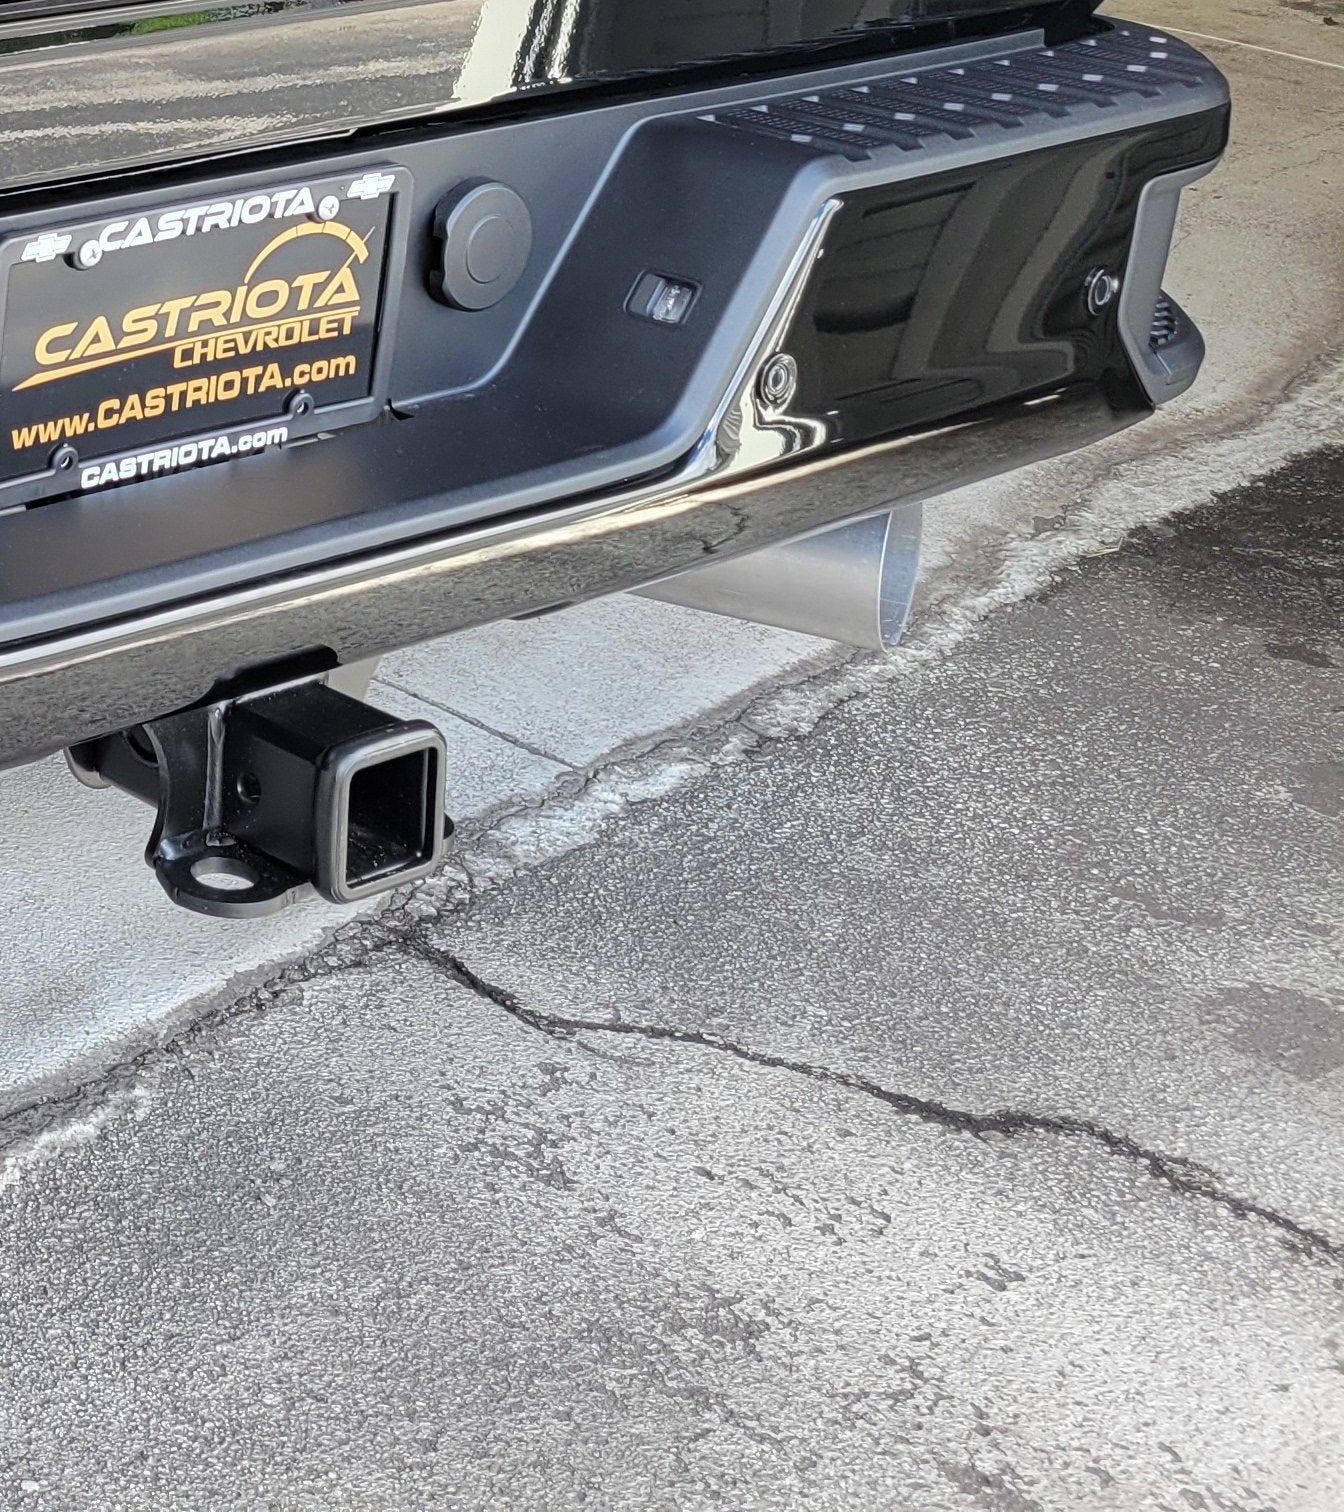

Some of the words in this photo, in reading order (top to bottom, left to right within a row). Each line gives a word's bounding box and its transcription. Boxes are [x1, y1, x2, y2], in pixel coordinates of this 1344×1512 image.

[98, 186, 316, 253] CASTRIOTA
[35, 266, 360, 365] CASTRIOTA
[173, 310, 359, 368] CHEVROLET
[10, 353, 358, 452] www.CASTRIOTA.com
[80, 425, 290, 490] CASTRIOTA.com
